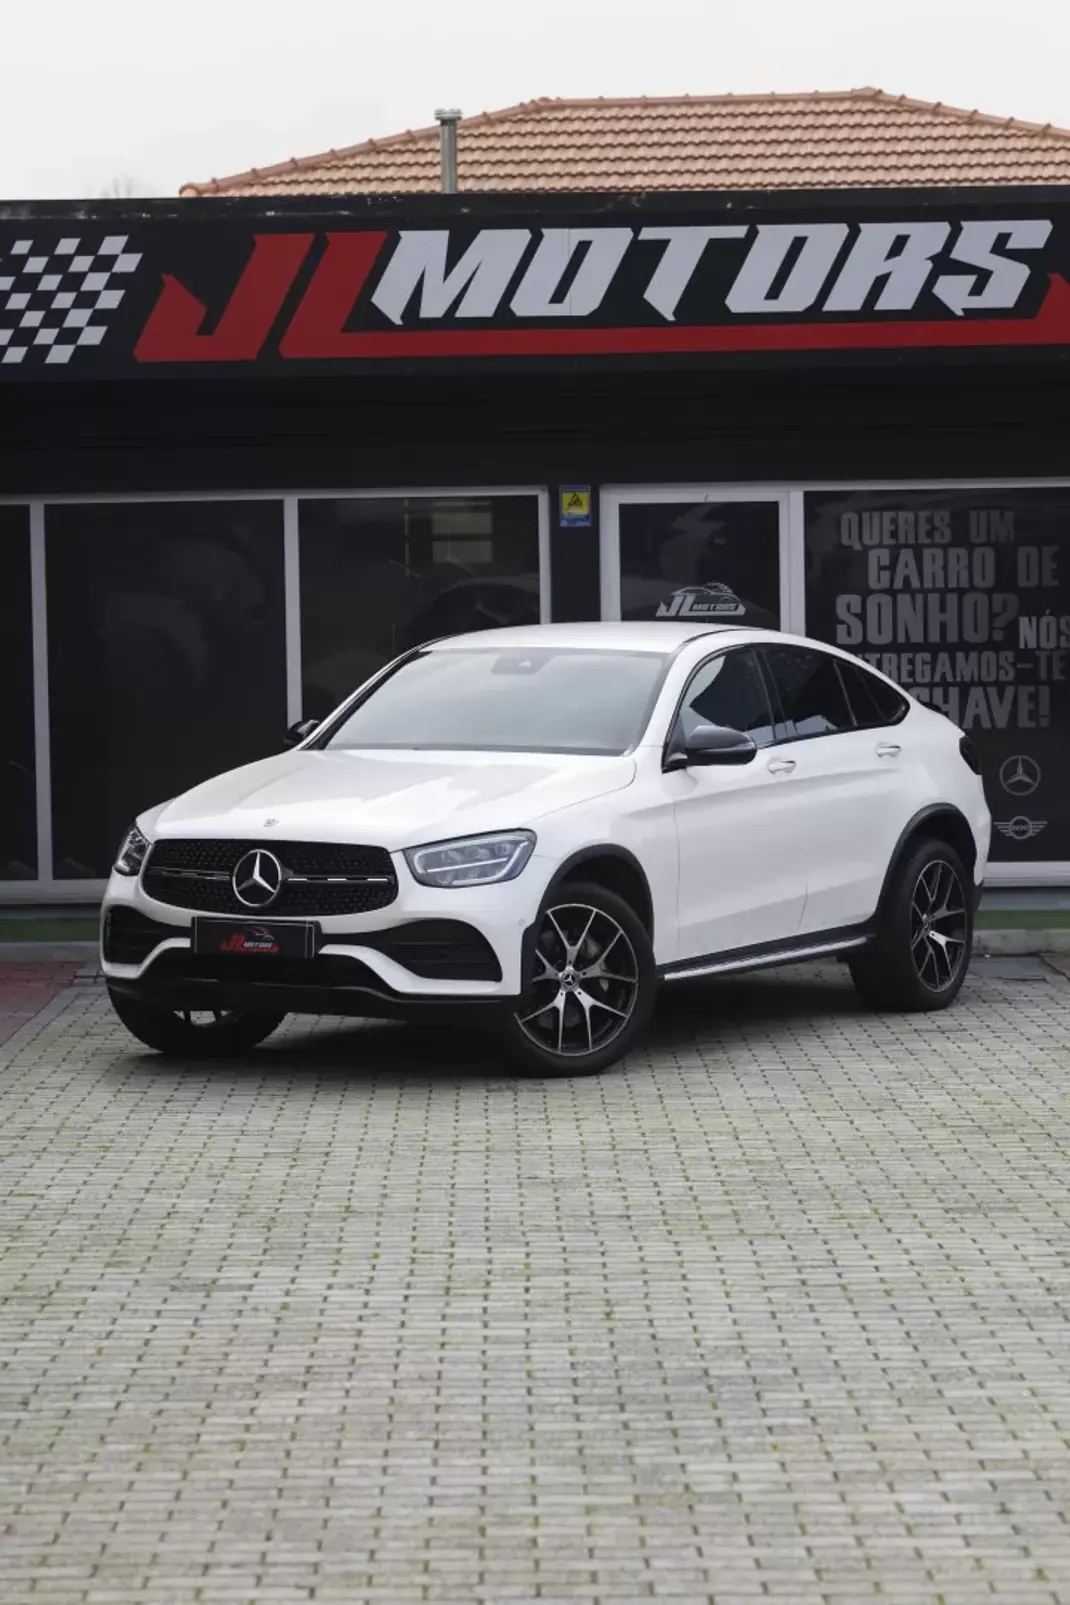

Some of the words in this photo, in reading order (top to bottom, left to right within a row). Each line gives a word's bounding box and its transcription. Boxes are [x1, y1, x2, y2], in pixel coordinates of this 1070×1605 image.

[133, 232, 387, 362] JL
[370, 219, 1053, 324] MOTORS
[840, 510, 951, 550] QUERES
[969, 510, 1016, 544] UM
[867, 547, 995, 590] CARRO
[1017, 545, 1060, 588] DE
[836, 592, 1020, 645] SONHO?
[857, 649, 1066, 684] TREGAMOS-TE
